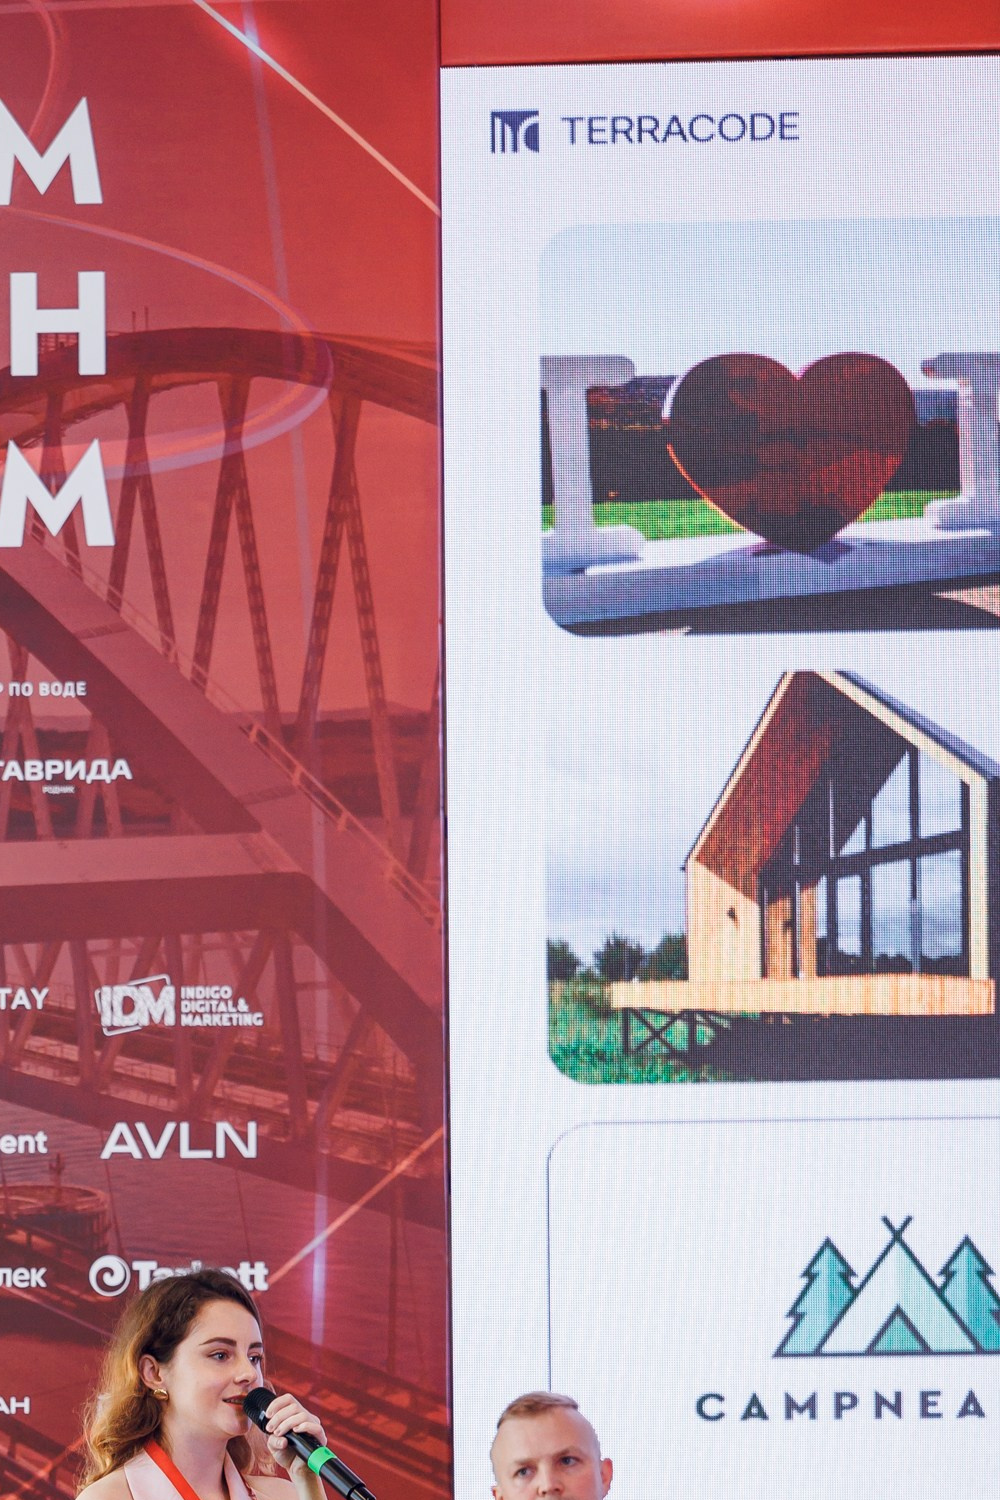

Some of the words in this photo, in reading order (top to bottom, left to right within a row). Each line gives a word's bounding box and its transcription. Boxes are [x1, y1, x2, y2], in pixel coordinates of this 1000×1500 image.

[561, 112, 800, 145] TERRACODE
[9, 682, 34, 697] ПО
[38, 681, 87, 699] ВОДЕ
[100, 985, 176, 1027] IDM
[181, 986, 232, 999] INDIGO
[181, 1013, 264, 1027] MARKETING
[100, 1121, 258, 1159] AVLN
[696, 1388, 986, 1422] CAMPNEA
